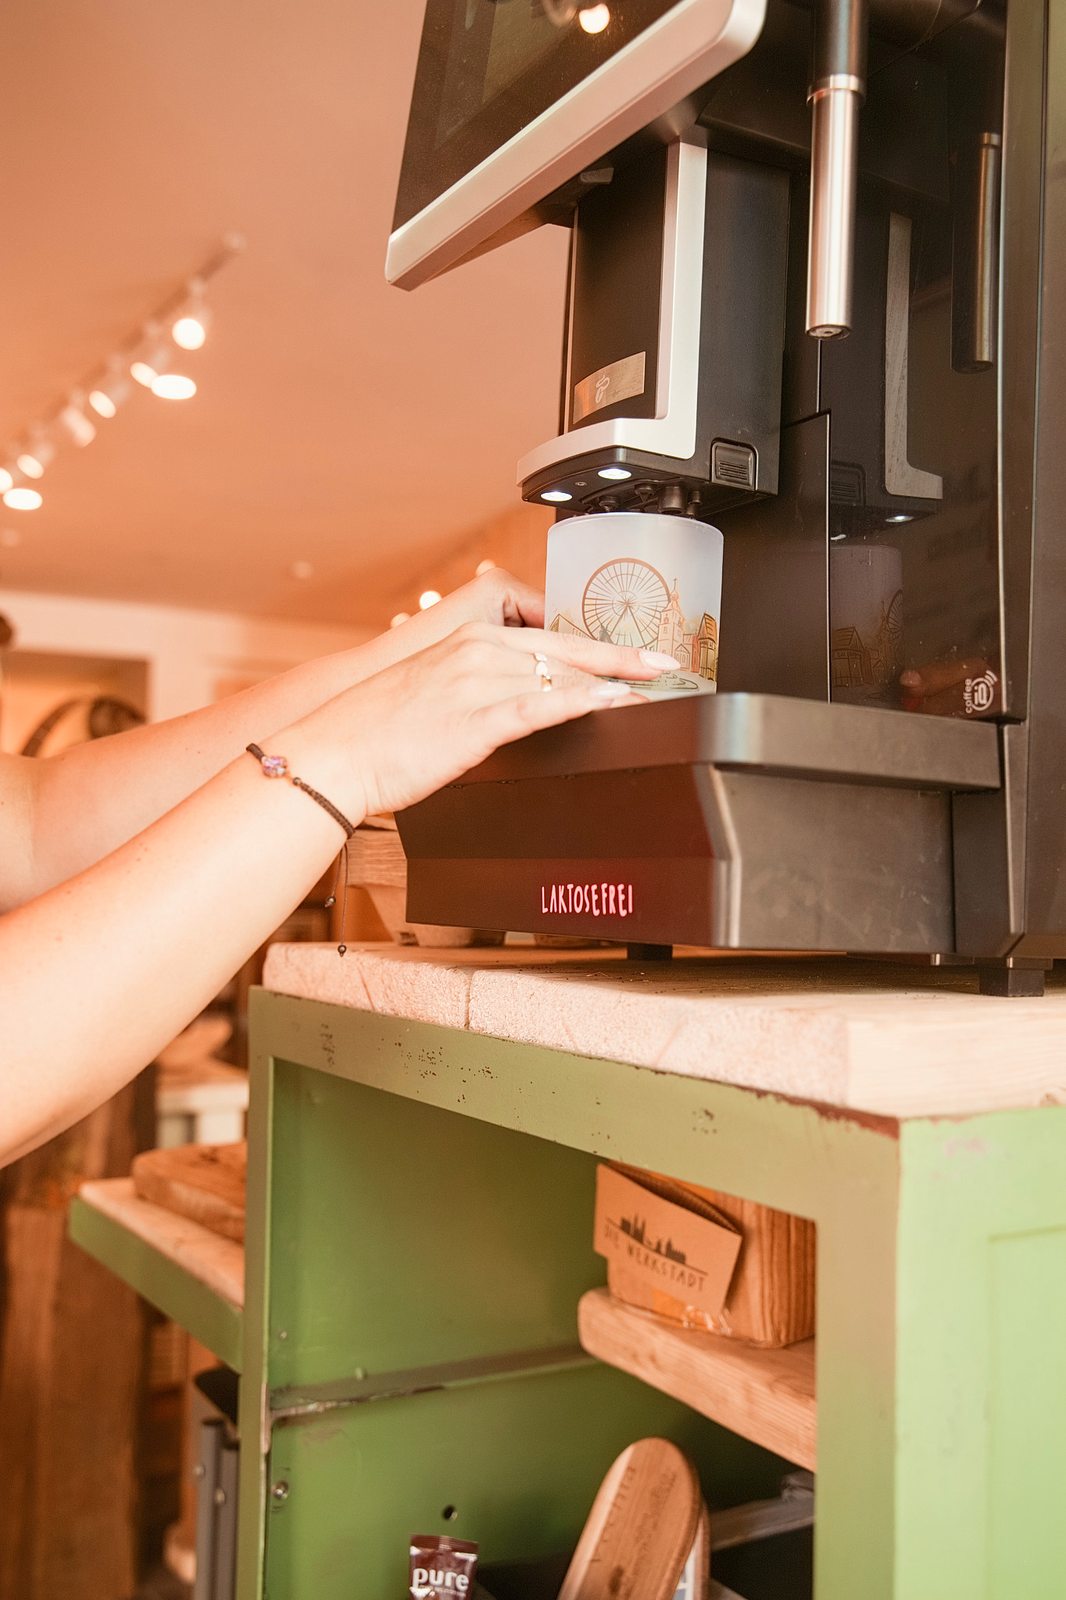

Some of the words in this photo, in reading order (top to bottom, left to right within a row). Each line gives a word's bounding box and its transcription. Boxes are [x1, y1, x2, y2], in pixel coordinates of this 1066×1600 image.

[963, 678, 973, 714] coffee
[541, 883, 633, 917] LAKTOSEFREI
[626, 1242, 706, 1292] WERKSTADT
[412, 1568, 470, 1592] pure
